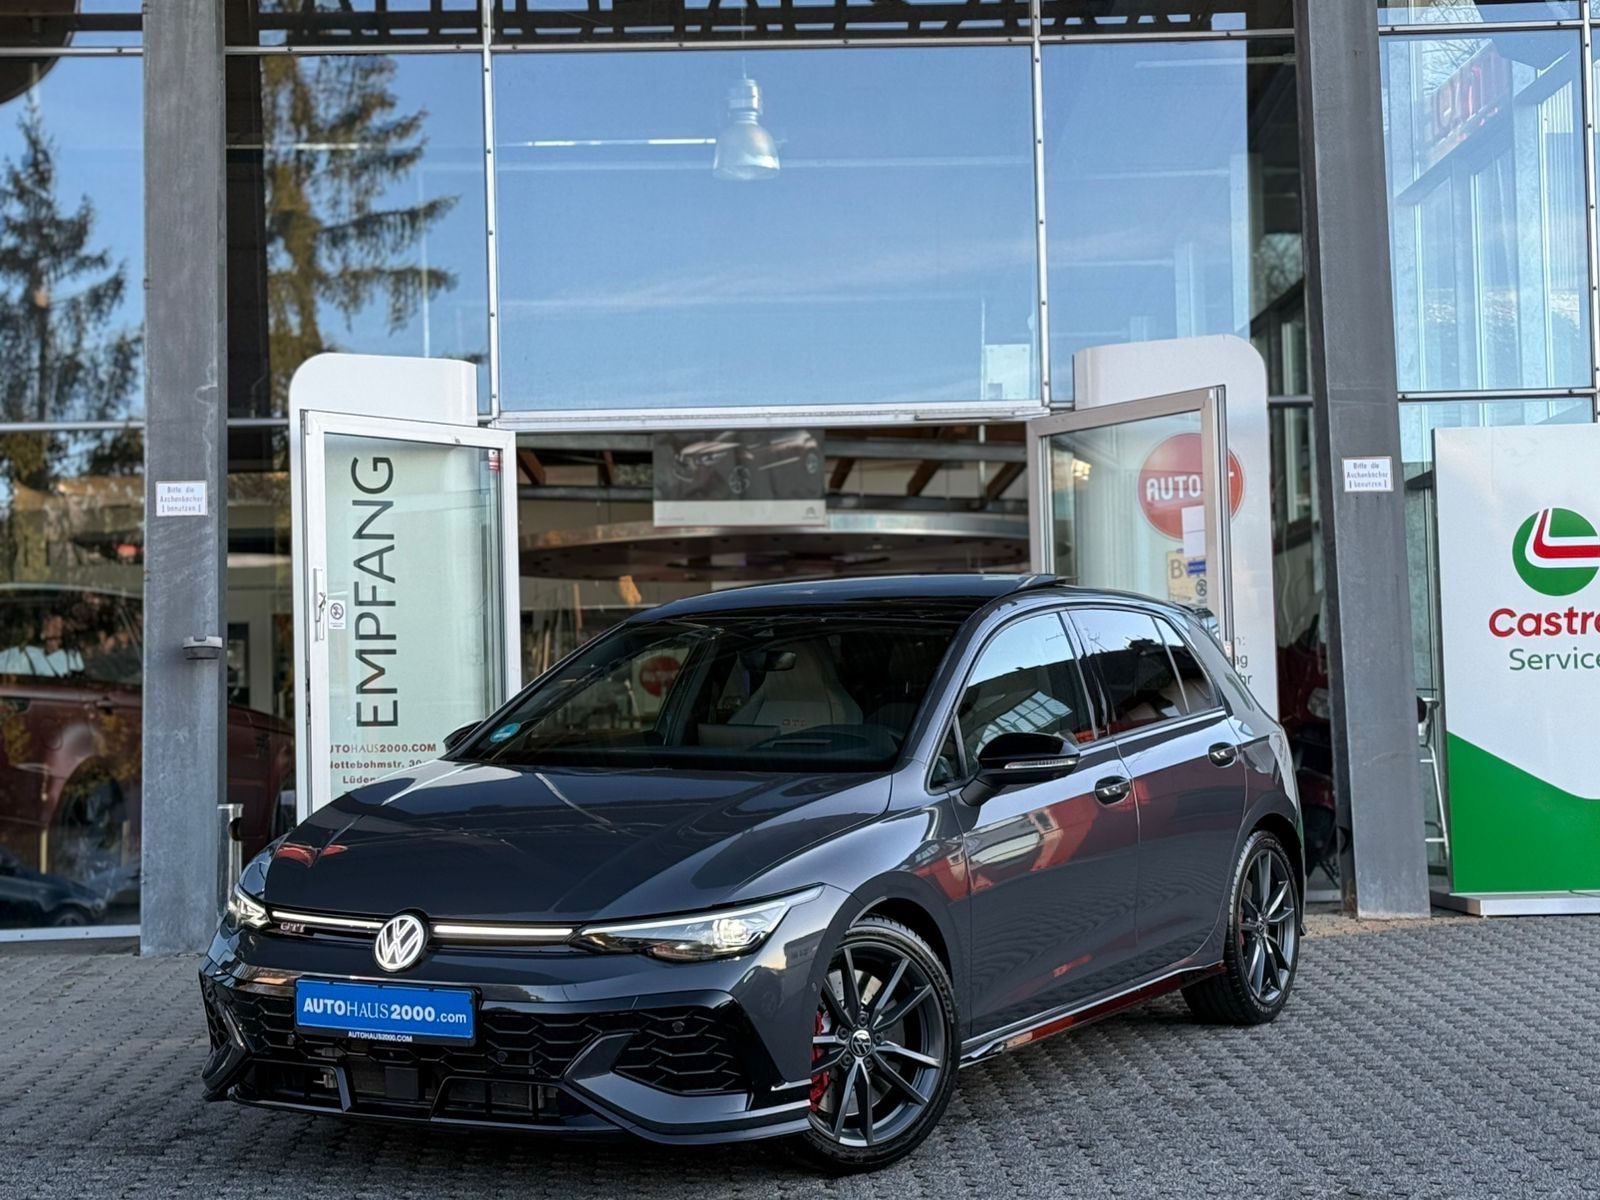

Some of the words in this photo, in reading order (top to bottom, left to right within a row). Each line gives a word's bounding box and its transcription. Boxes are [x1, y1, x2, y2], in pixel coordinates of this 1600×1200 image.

[351, 457, 398, 727] EMPFANG
[1488, 606, 1600, 638] Castr
[280, 921, 306, 933] GTI
[303, 997, 467, 1024] AUTOHAUS2000.com
[348, 1031, 413, 1042] AUTOHAUS2000.COM
